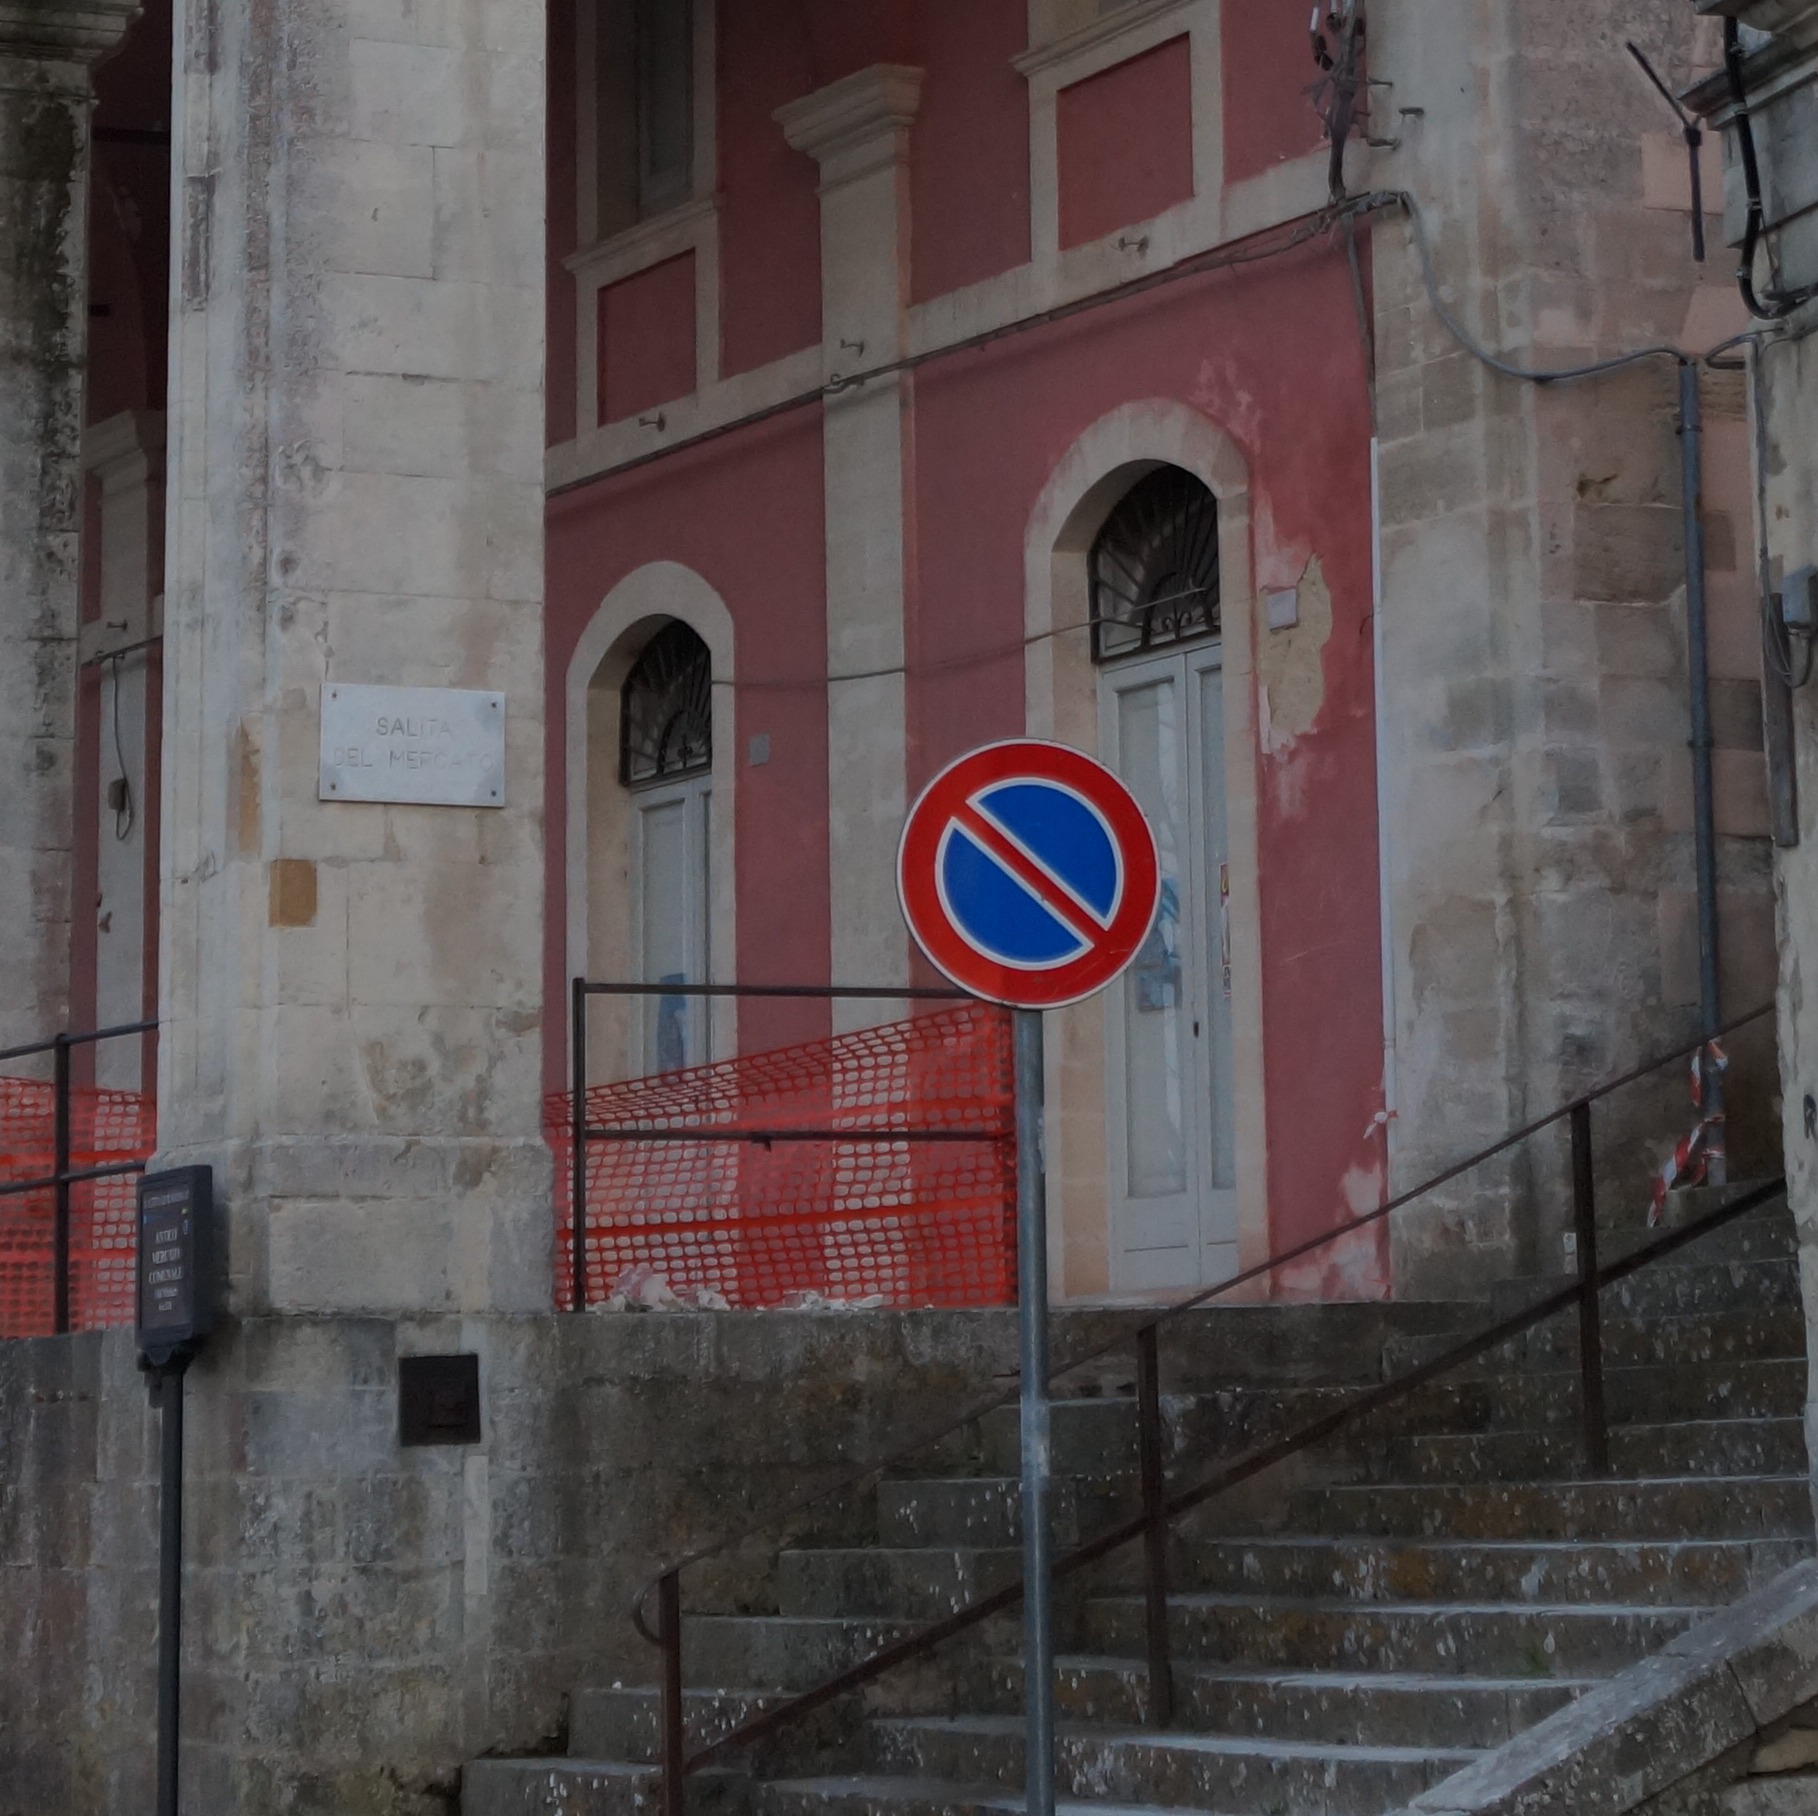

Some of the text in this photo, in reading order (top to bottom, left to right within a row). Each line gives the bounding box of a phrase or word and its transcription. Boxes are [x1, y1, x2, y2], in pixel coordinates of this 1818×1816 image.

[375, 716, 452, 738] SALITA
[333, 747, 495, 773] DEL MERCATO
